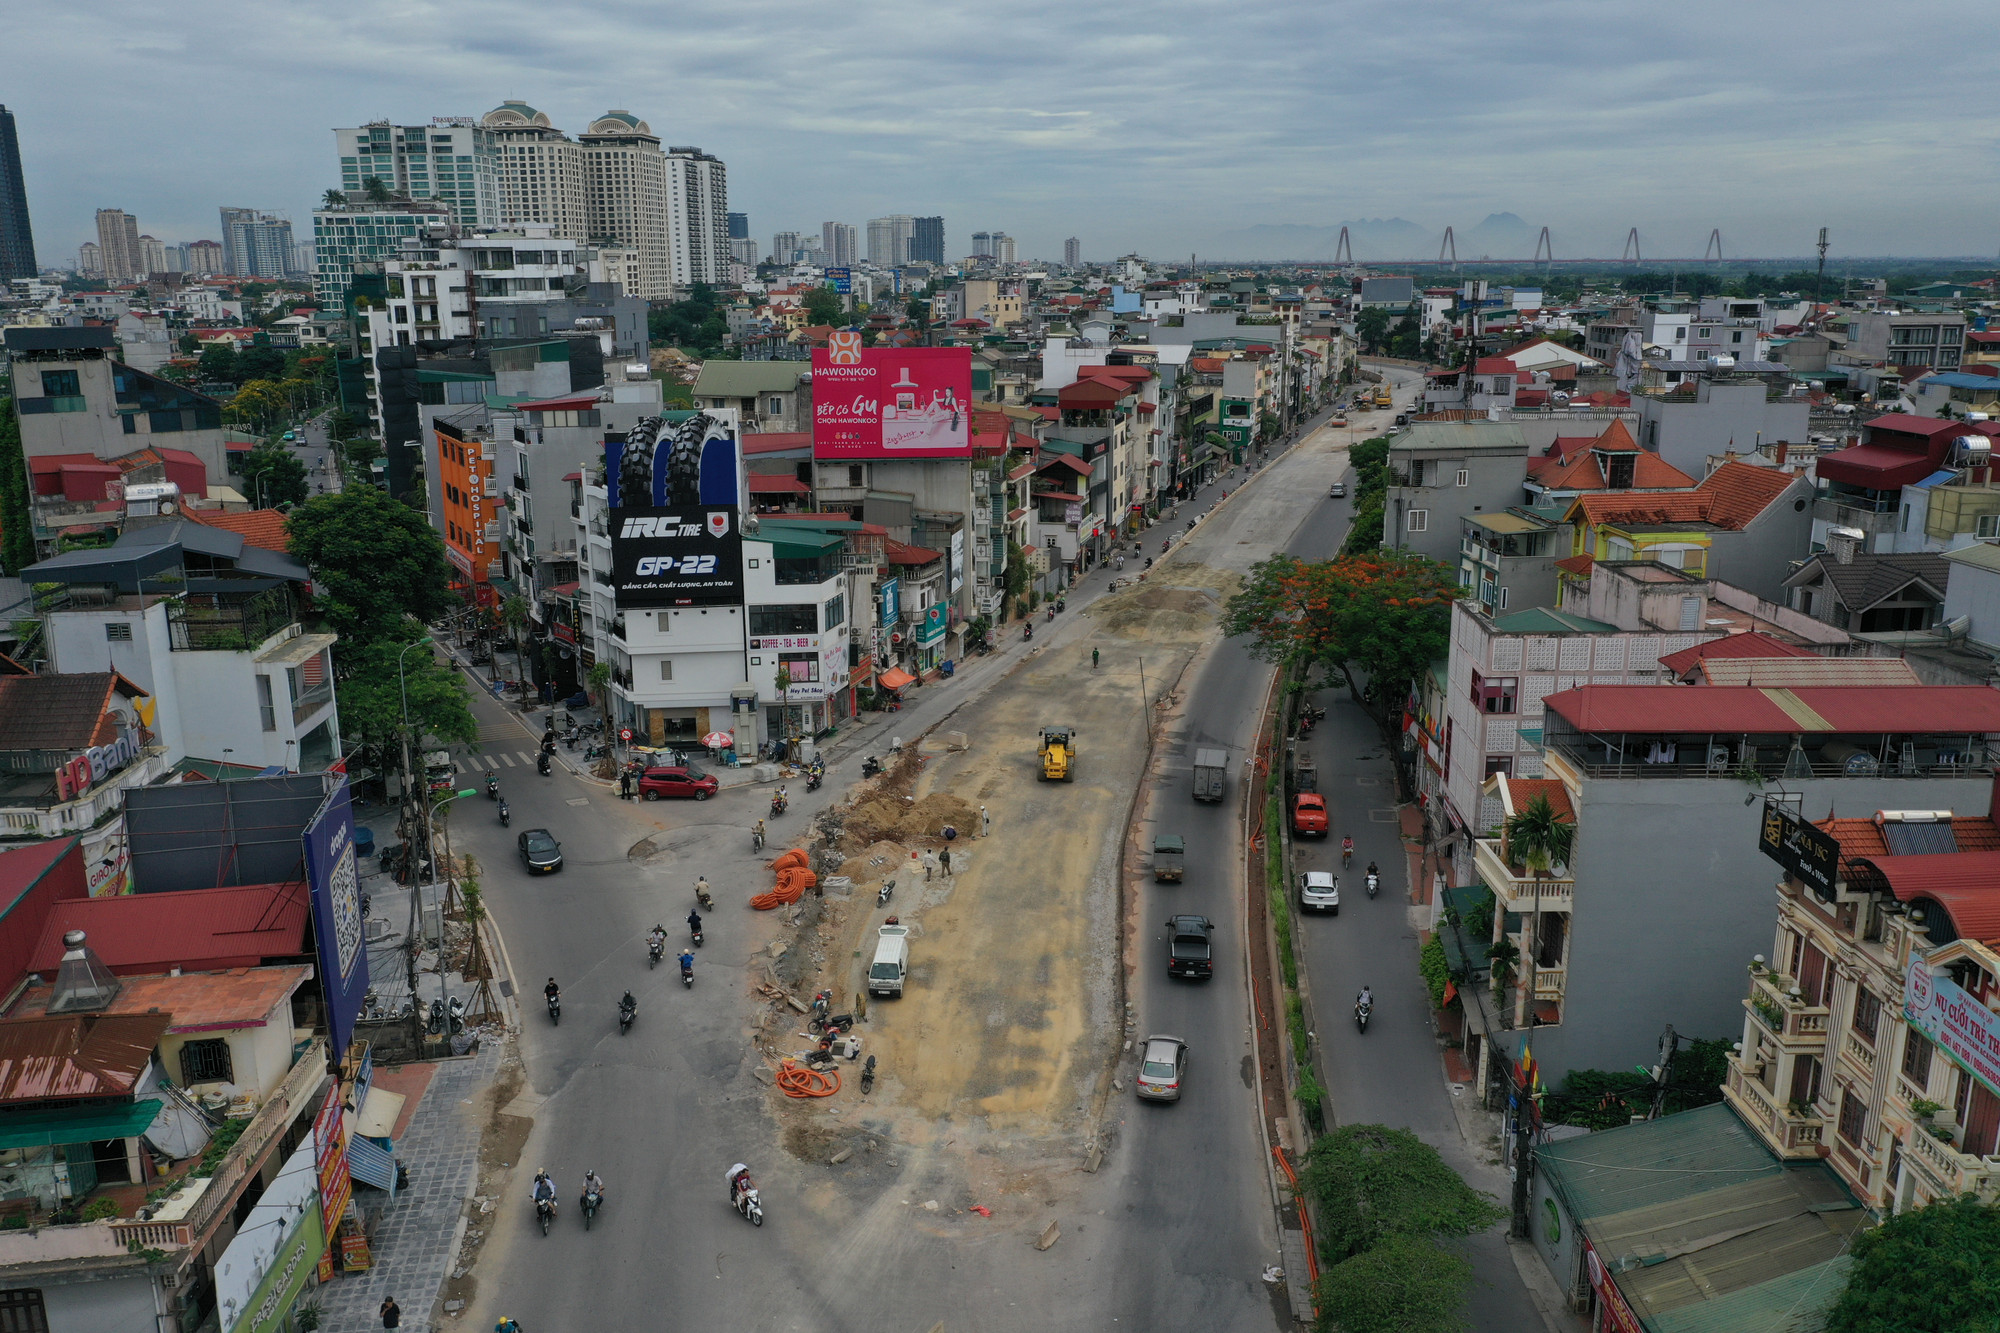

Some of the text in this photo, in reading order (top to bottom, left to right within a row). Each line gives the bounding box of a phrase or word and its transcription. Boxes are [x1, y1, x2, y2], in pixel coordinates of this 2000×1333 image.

[814, 367, 877, 376] HAWONKOO
[816, 402, 835, 416] BẾP
[467, 448, 477, 473] PET
[470, 486, 484, 554] HOSPITAL
[678, 523, 703, 537] TIRE
[636, 555, 718, 576] GP-22
[762, 638, 778, 648] COFFEE
[783, 638, 792, 648] TEA
[797, 637, 809, 648] BEER
[55, 727, 142, 802] HDBank
[1813, 842, 1829, 862] JSC
[1800, 859, 1812, 873] Food
[1815, 869, 1829, 886] Wine
[1935, 992, 1948, 1017] NỤ
[1970, 1020, 1987, 1045] TRẺ
[1988, 1034, 2000, 1056] TH
[276, 1240, 307, 1293] GARDEN
